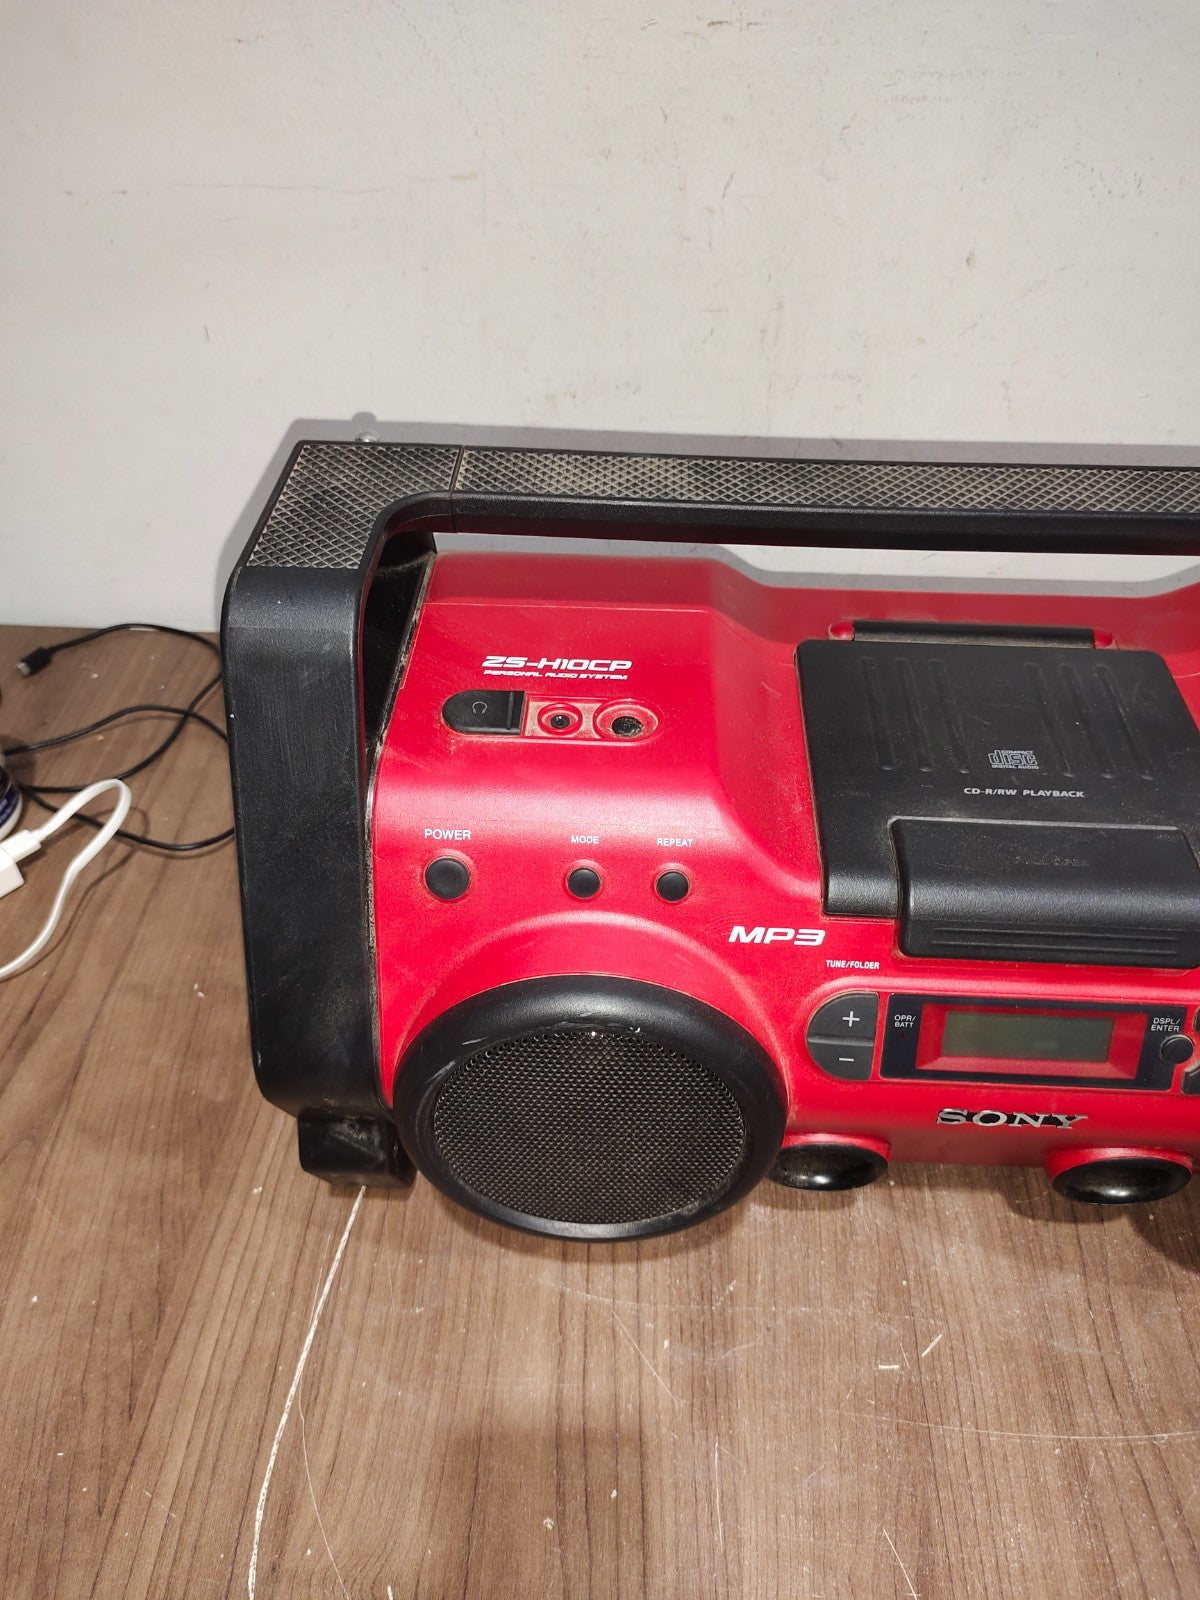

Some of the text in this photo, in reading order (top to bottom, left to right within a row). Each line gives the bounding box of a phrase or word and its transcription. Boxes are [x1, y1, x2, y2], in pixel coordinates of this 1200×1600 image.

[482, 655, 632, 672] ZS-H10CP
[484, 669, 543, 677] PERSONAL
[963, 787, 1086, 798] CD-R/RW PLAYBACK
[424, 829, 472, 841] POWER
[571, 835, 600, 845] MODE
[656, 837, 694, 848] REPEAT
[728, 925, 826, 946] MP3
[825, 959, 880, 970] TUNE/FOLDER
[893, 1014, 917, 1022] OPR/
[1153, 1017, 1181, 1025] DSPL/
[1150, 1024, 1180, 1032] ENTER
[936, 1108, 1089, 1130] SONY
